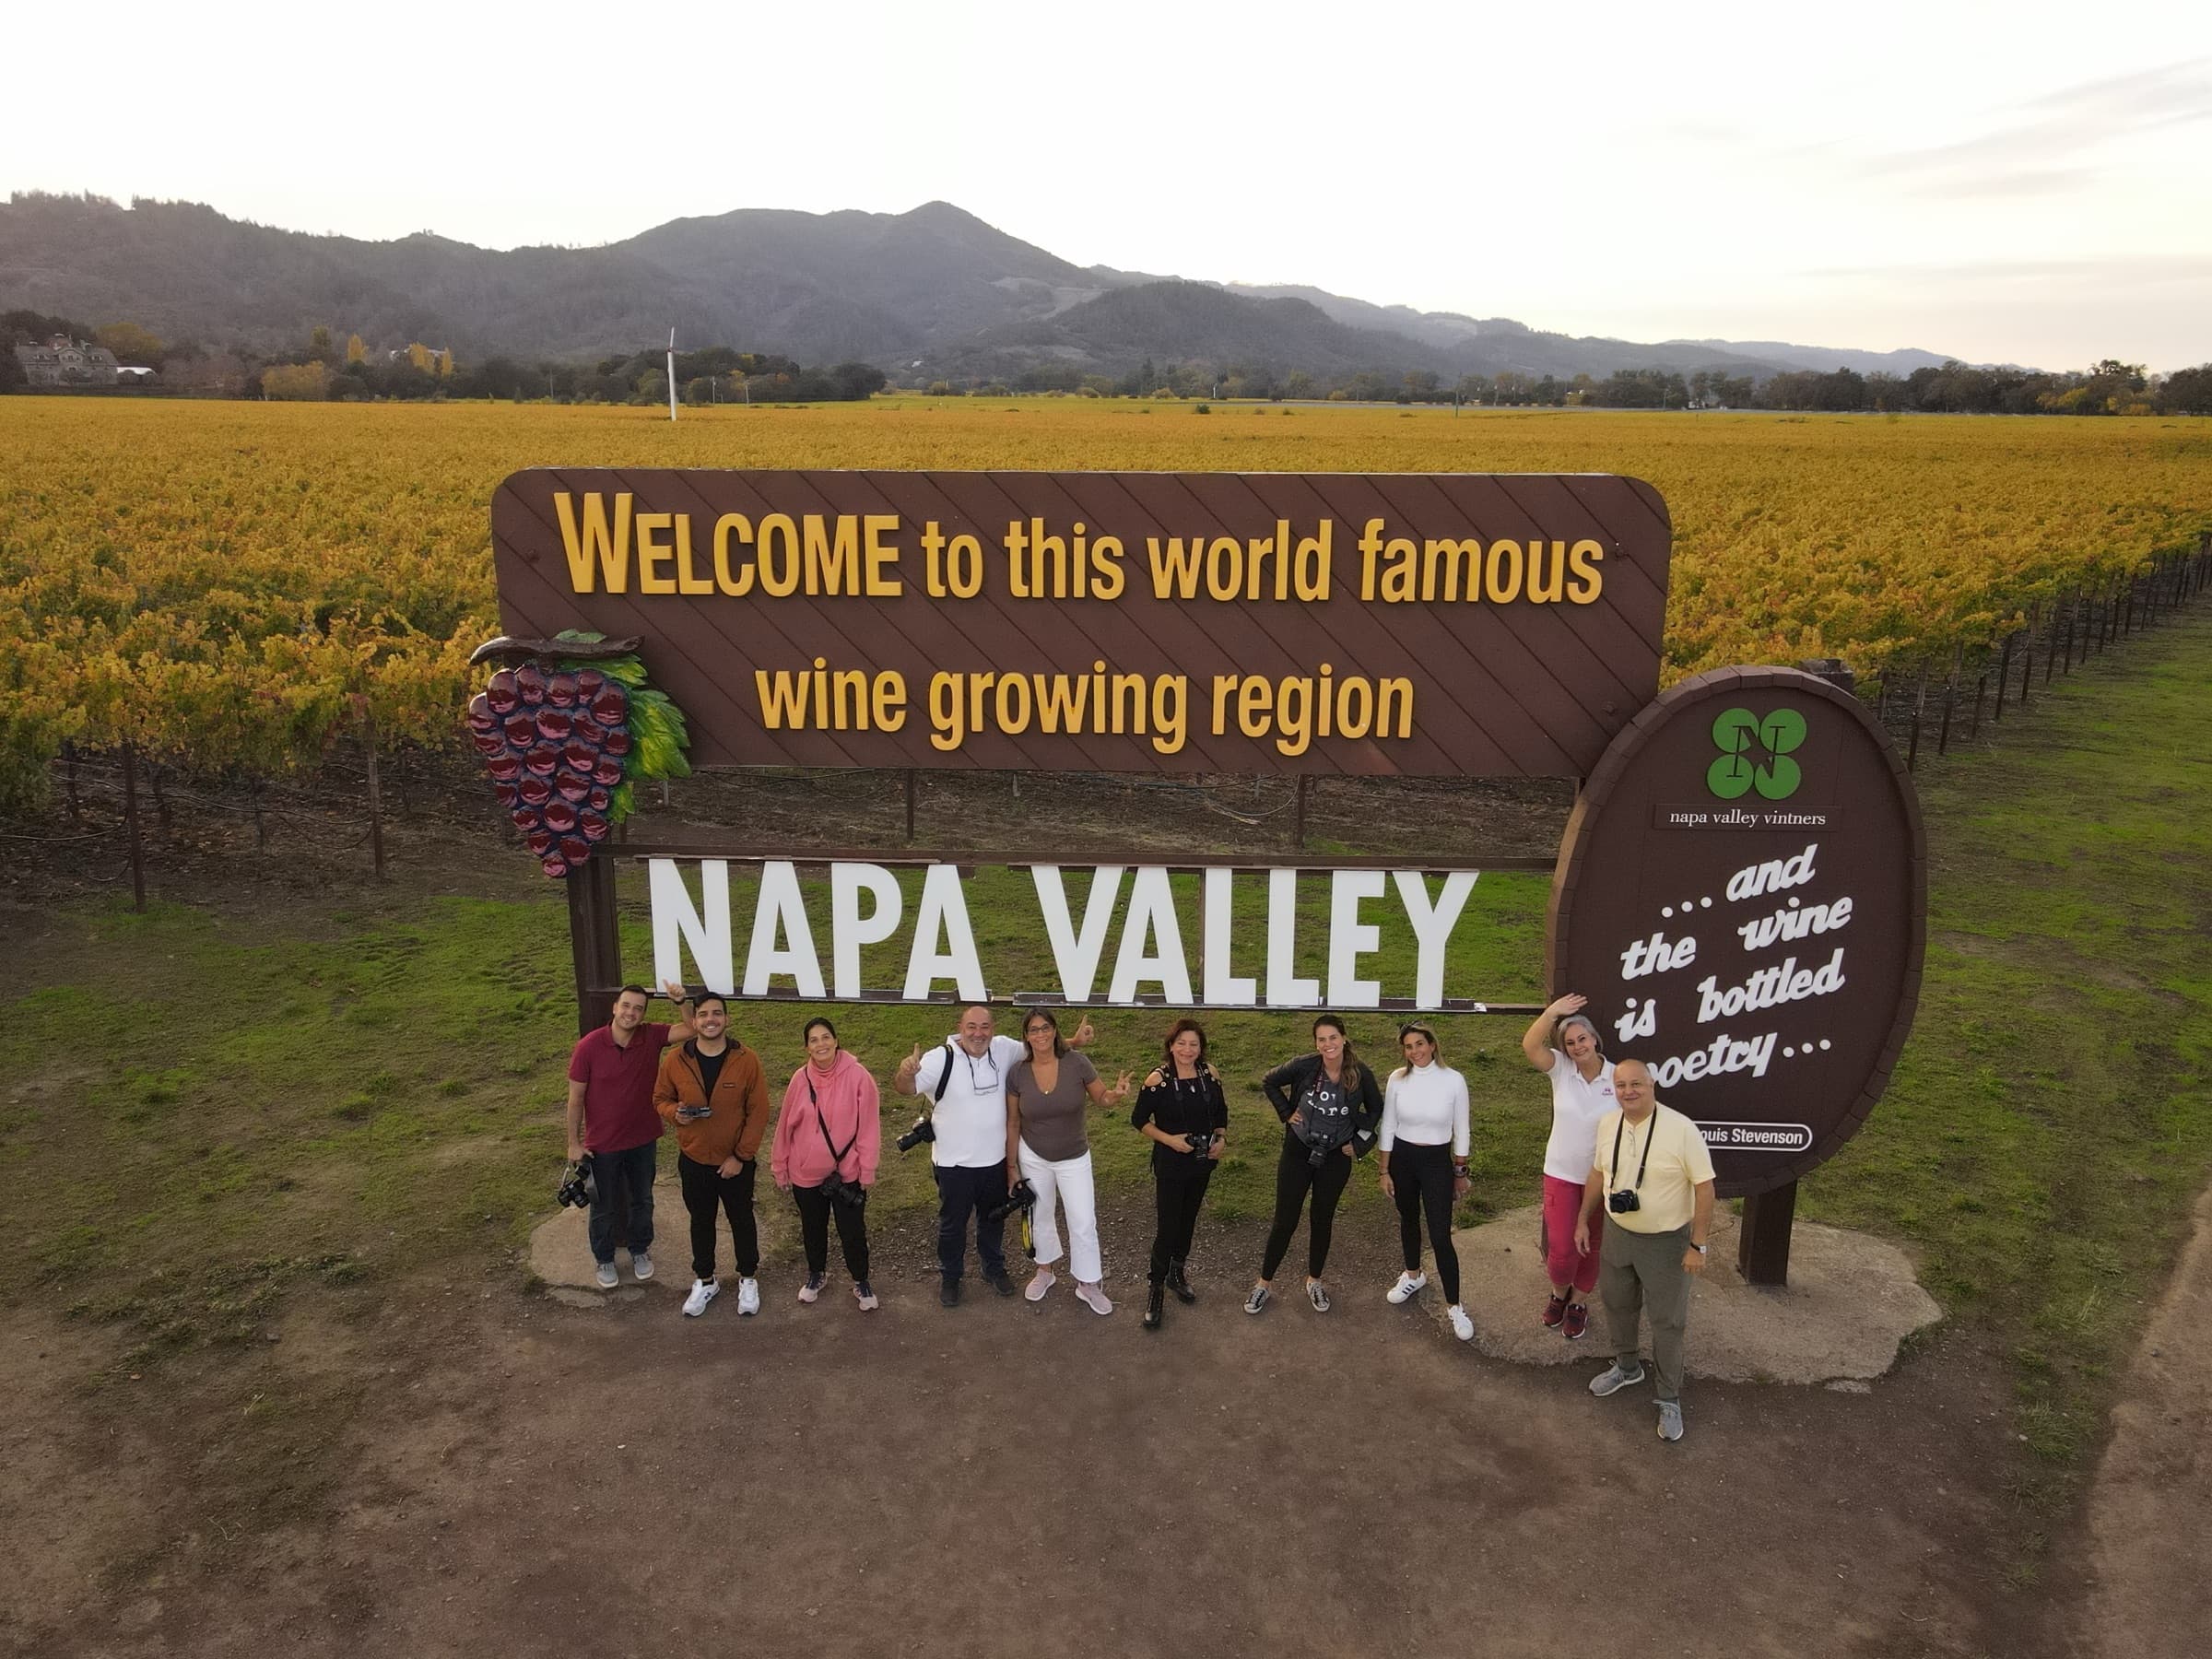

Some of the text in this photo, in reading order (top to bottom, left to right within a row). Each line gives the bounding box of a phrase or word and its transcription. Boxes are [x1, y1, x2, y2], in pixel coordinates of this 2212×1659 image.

[553, 492, 1604, 605] WELCOME to this world famous
[755, 656, 1414, 757] wine growing region
[1670, 808, 1827, 829] napa valley vintners
[649, 858, 1478, 1011] NAPA VALLEY
[1620, 897, 1853, 981] the wine
[1614, 947, 1846, 1042] is bottled
[1700, 1128, 1804, 1146] ouis Stevenson
